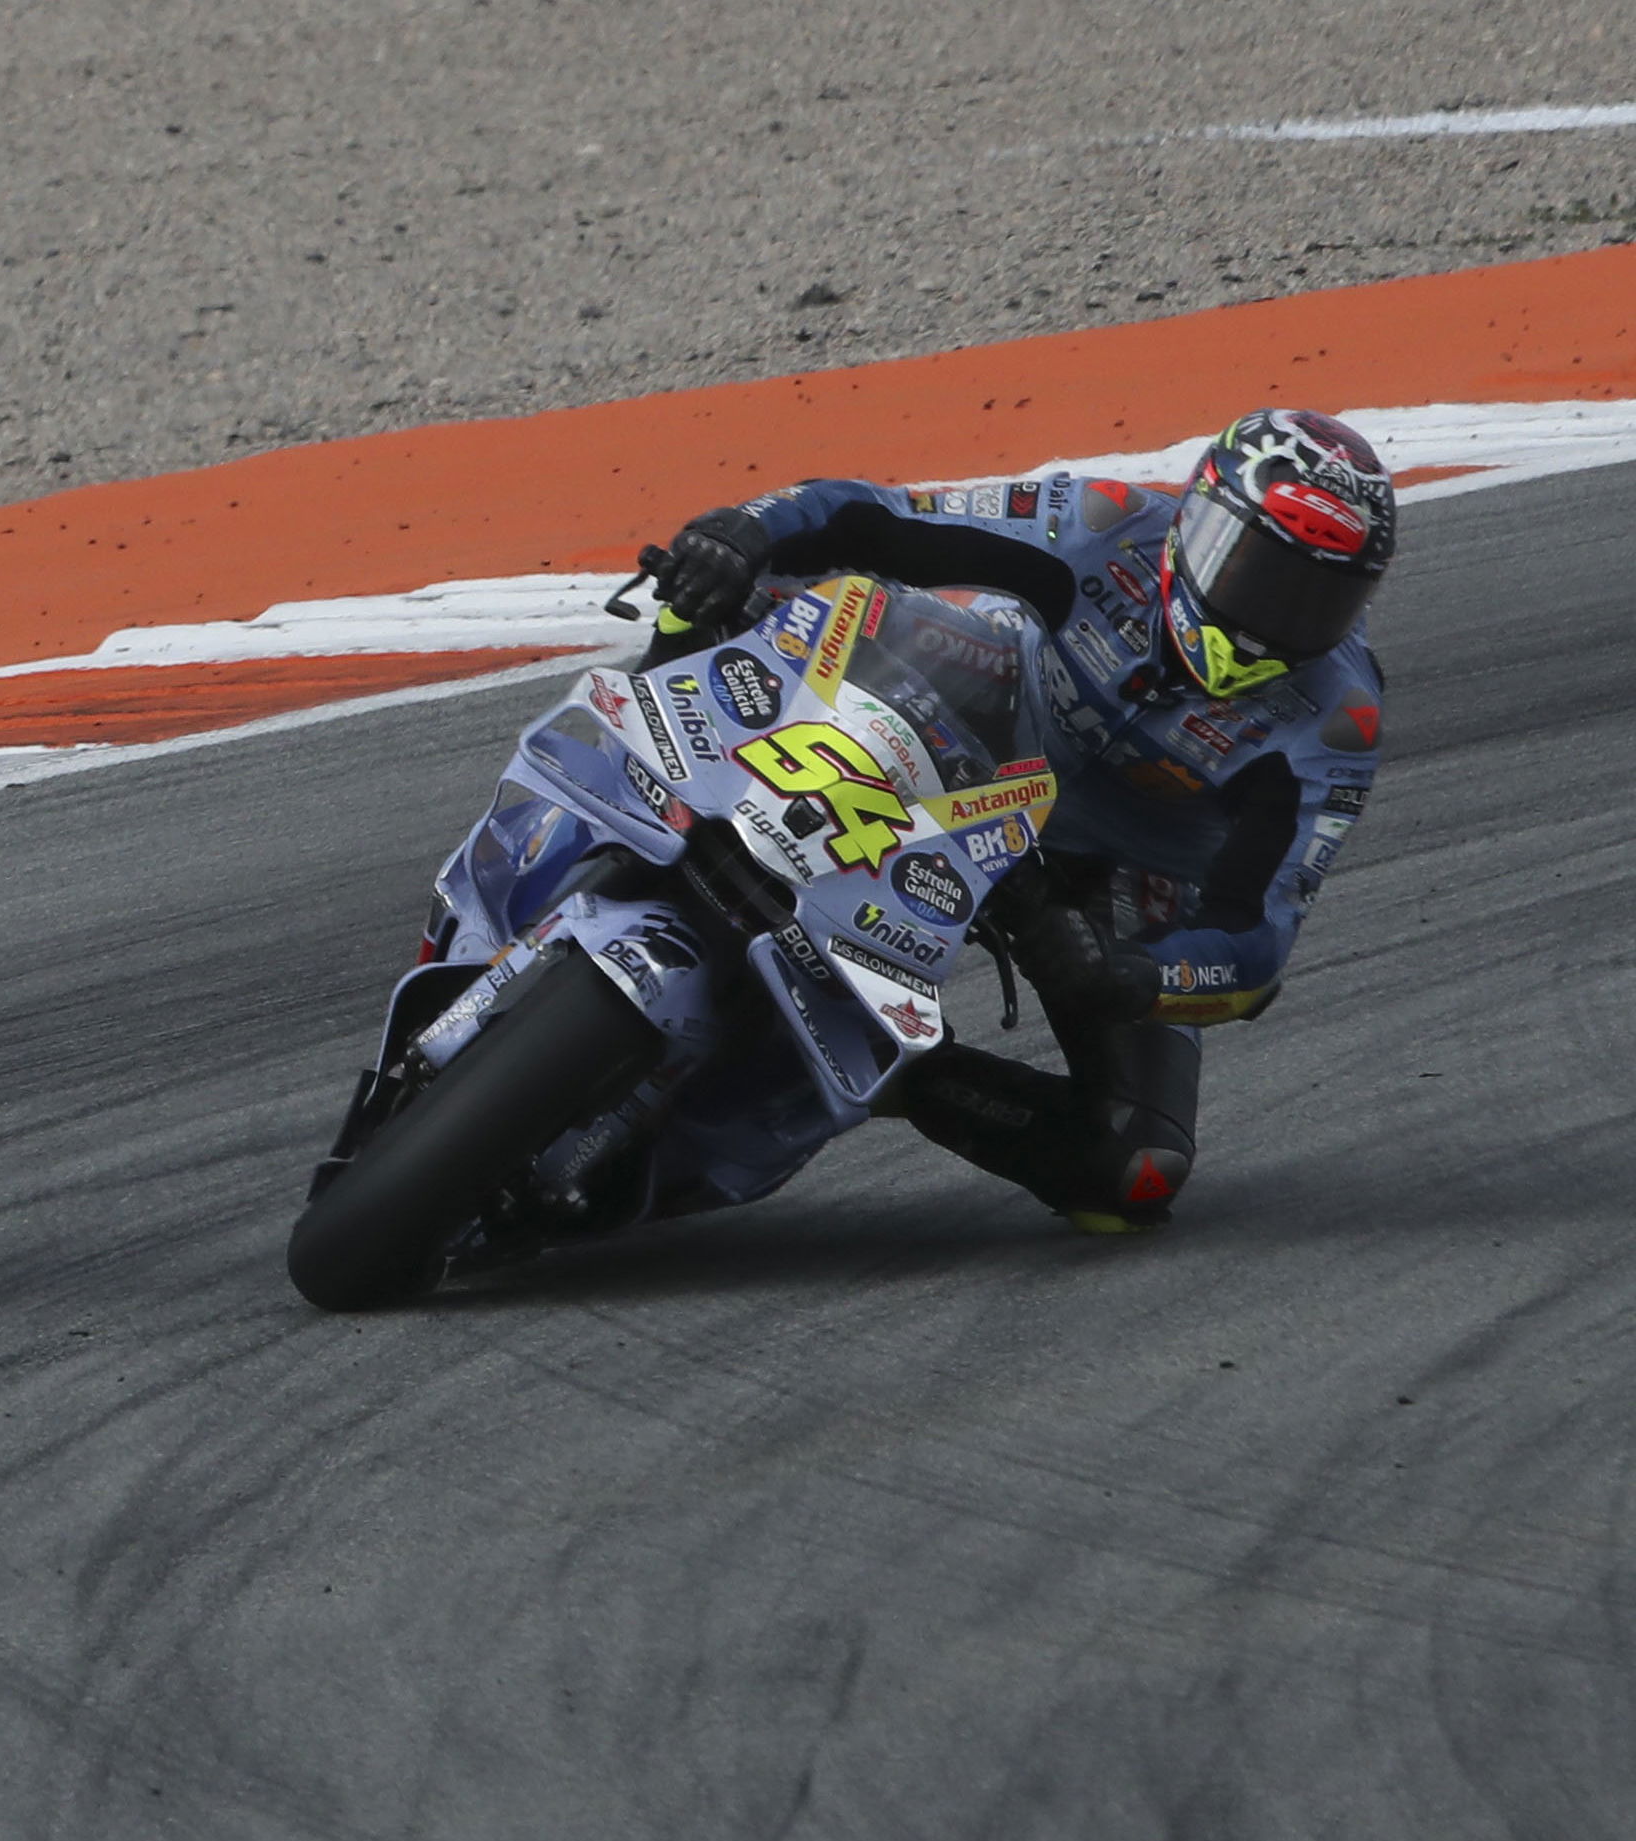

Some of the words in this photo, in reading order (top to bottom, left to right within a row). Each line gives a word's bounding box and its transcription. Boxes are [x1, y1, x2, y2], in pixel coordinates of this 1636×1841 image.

[771, 597, 821, 661] BK8
[816, 582, 867, 678] Antangin
[721, 663, 755, 718] Galicia
[735, 658, 772, 716] Estrella
[666, 674, 723, 762] Unibat
[882, 715, 915, 746] AUS
[869, 718, 921, 787] GLOBAL
[626, 756, 666, 807] BOLD
[731, 721, 915, 880] 54
[950, 780, 1049, 822] Antangin
[966, 816, 1028, 863] BK8
[982, 857, 1009, 874] NEWS
[905, 877, 956, 915] Galicia
[906, 860, 963, 901] Estrella
[781, 923, 831, 981] BOLD
[853, 900, 948, 967] Unibat
[854, 952, 893, 979] GLOW
